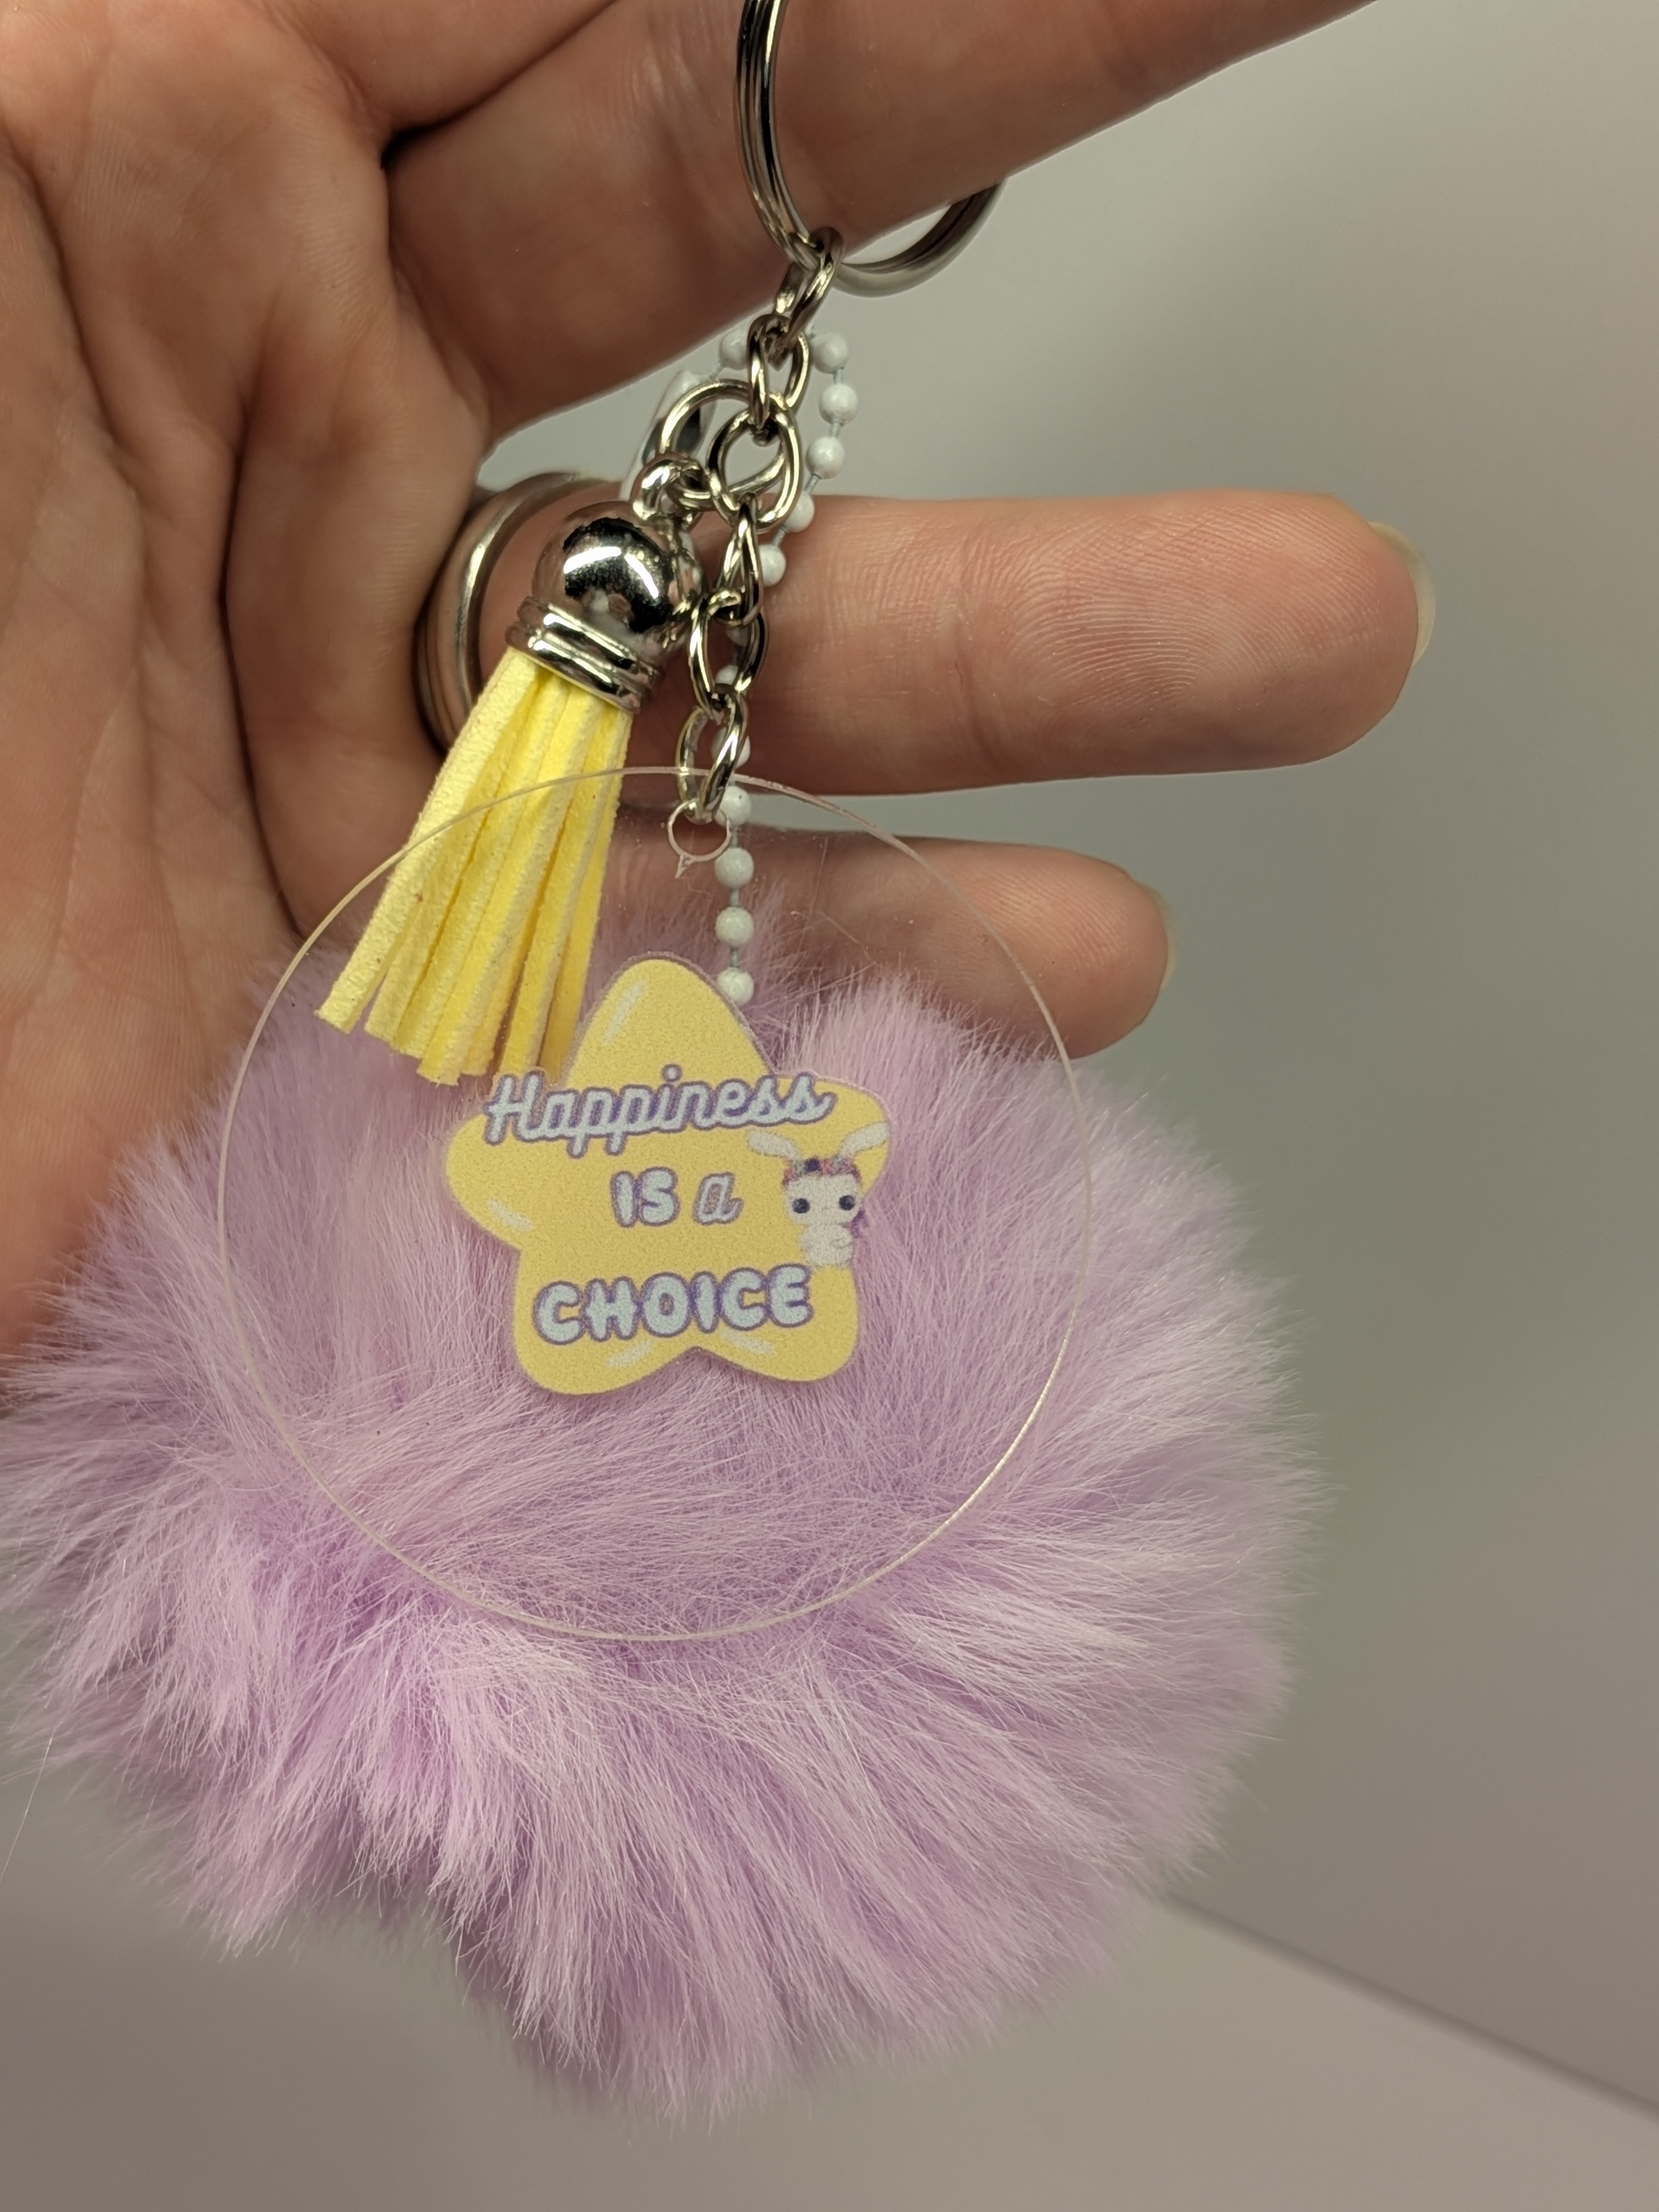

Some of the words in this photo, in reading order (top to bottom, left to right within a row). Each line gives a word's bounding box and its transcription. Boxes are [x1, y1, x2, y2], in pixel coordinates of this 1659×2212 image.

[484, 1065, 837, 1157] Happiness
[611, 1167, 678, 1227] IS
[693, 1172, 743, 1225] a
[533, 1264, 813, 1345] CHOICE
